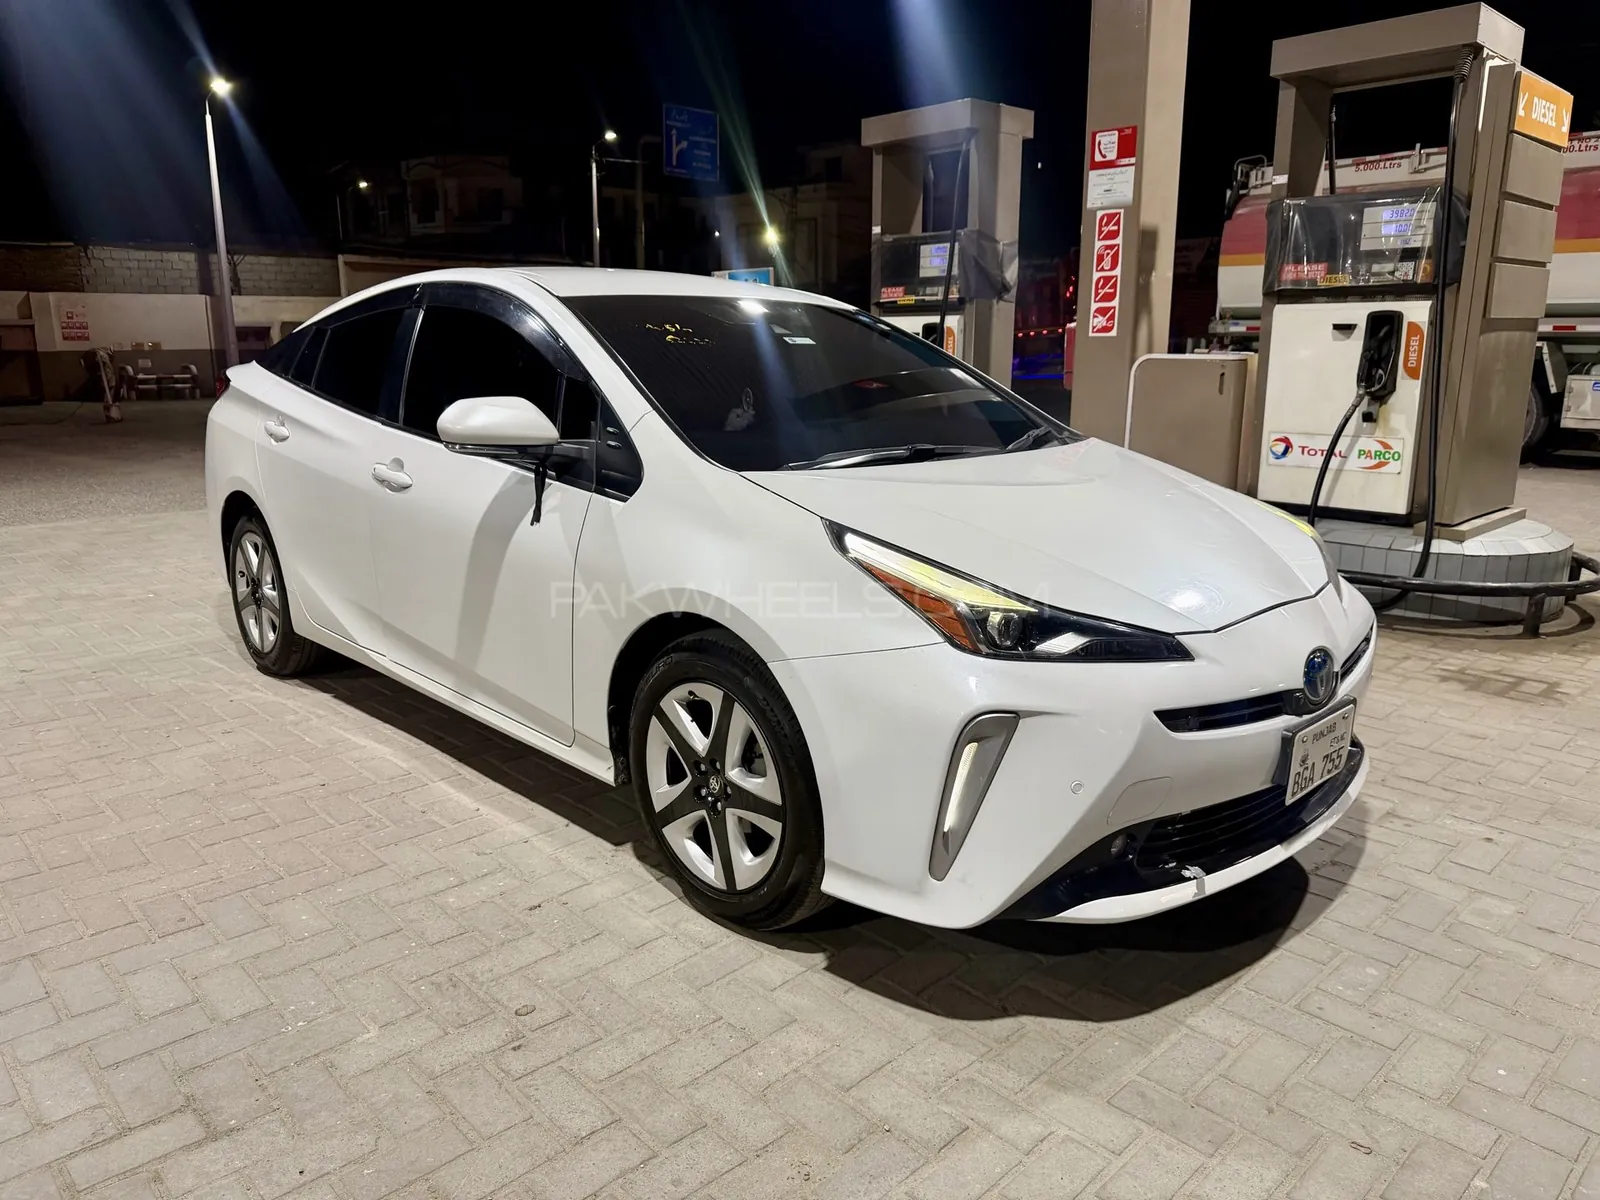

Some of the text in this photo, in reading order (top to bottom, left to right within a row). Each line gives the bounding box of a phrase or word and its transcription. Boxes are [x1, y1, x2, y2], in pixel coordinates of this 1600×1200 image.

[1532, 96, 1556, 127] DIESEL
[1407, 335, 1420, 367] DIESEL
[1357, 448, 1401, 461] PARCO
[1312, 722, 1337, 744] PUNJAB
[1291, 746, 1345, 797] BGA 755
